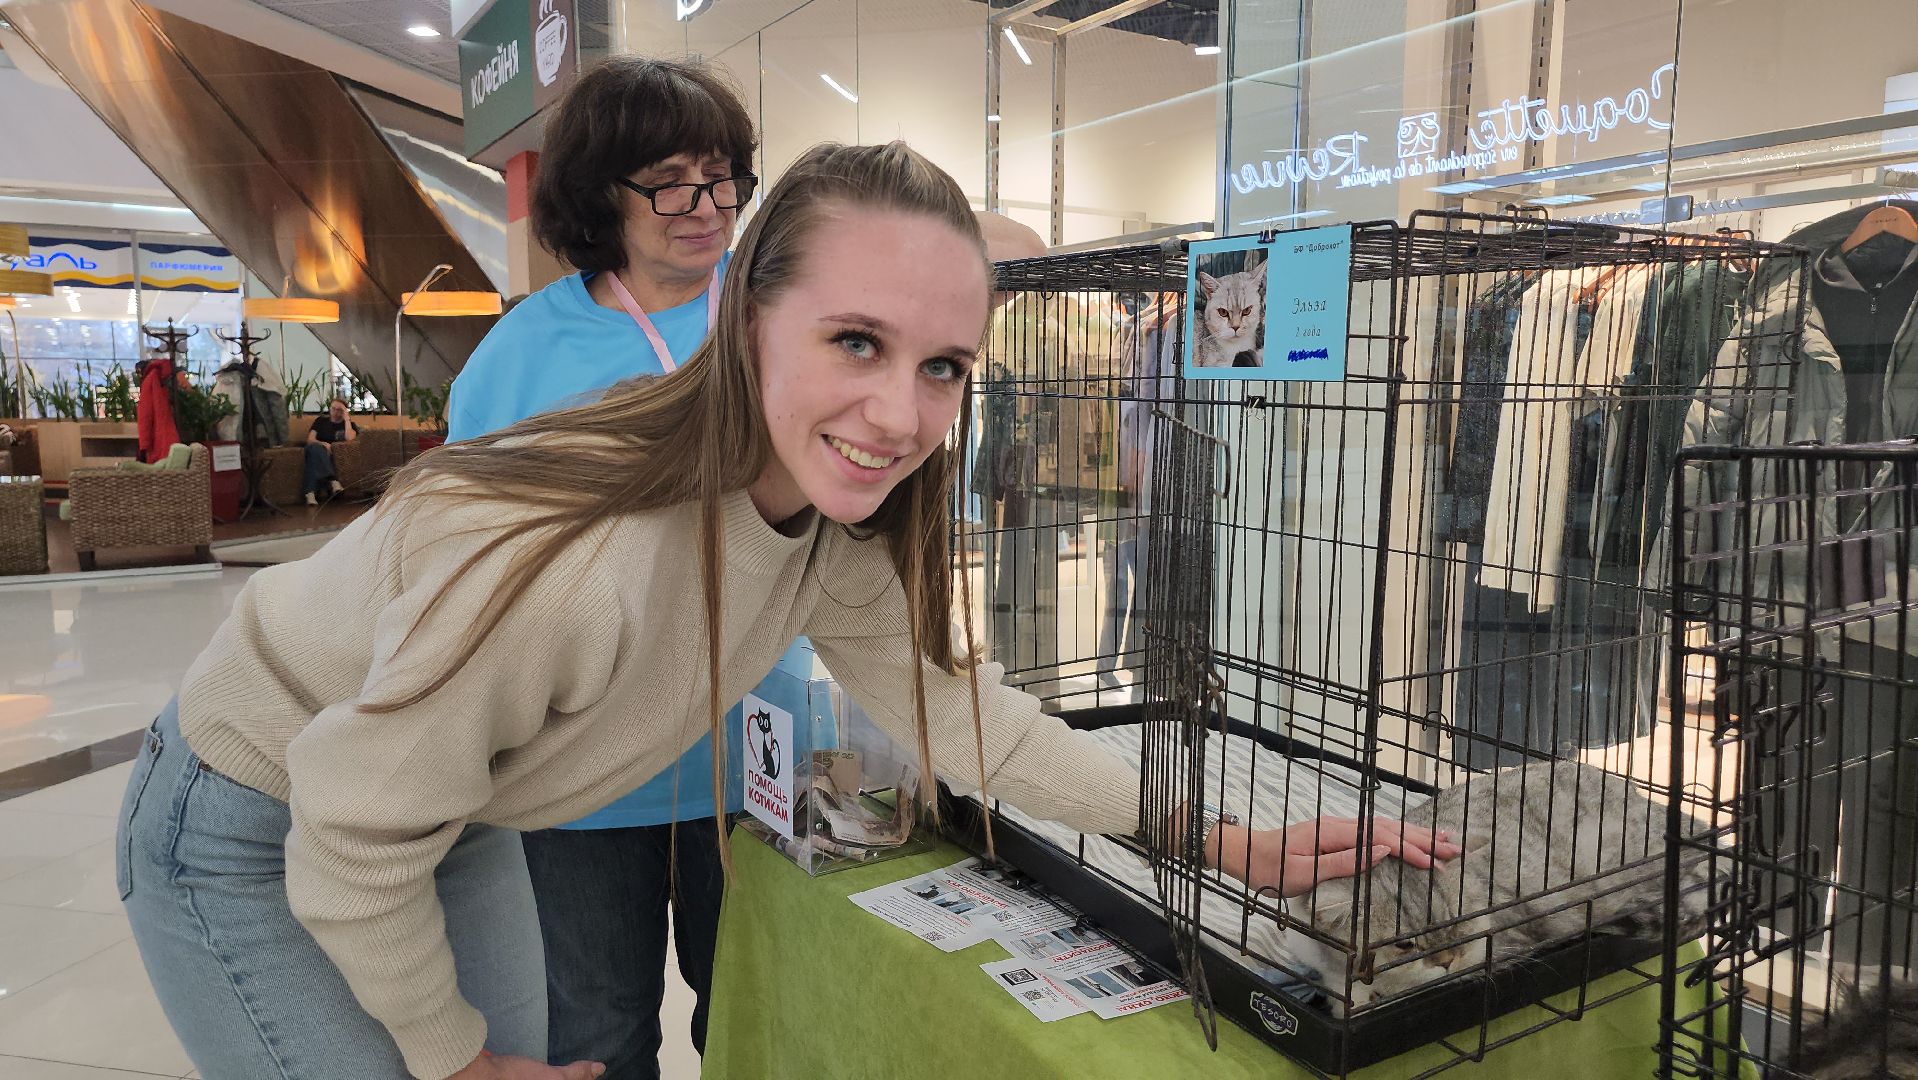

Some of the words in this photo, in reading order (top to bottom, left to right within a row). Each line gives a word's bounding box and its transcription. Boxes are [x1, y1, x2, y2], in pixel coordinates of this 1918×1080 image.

[470, 39, 519, 109] КОФЕЙНЯ
[149, 261, 223, 271] ПАРФЮМЕРИЯ
[1291, 297, 1327, 315] Эльза
[748, 768, 788, 804] ПОМОЩЬ
[748, 786, 789, 824] КОТИКАМ
[1253, 998, 1293, 1028] TESORO
